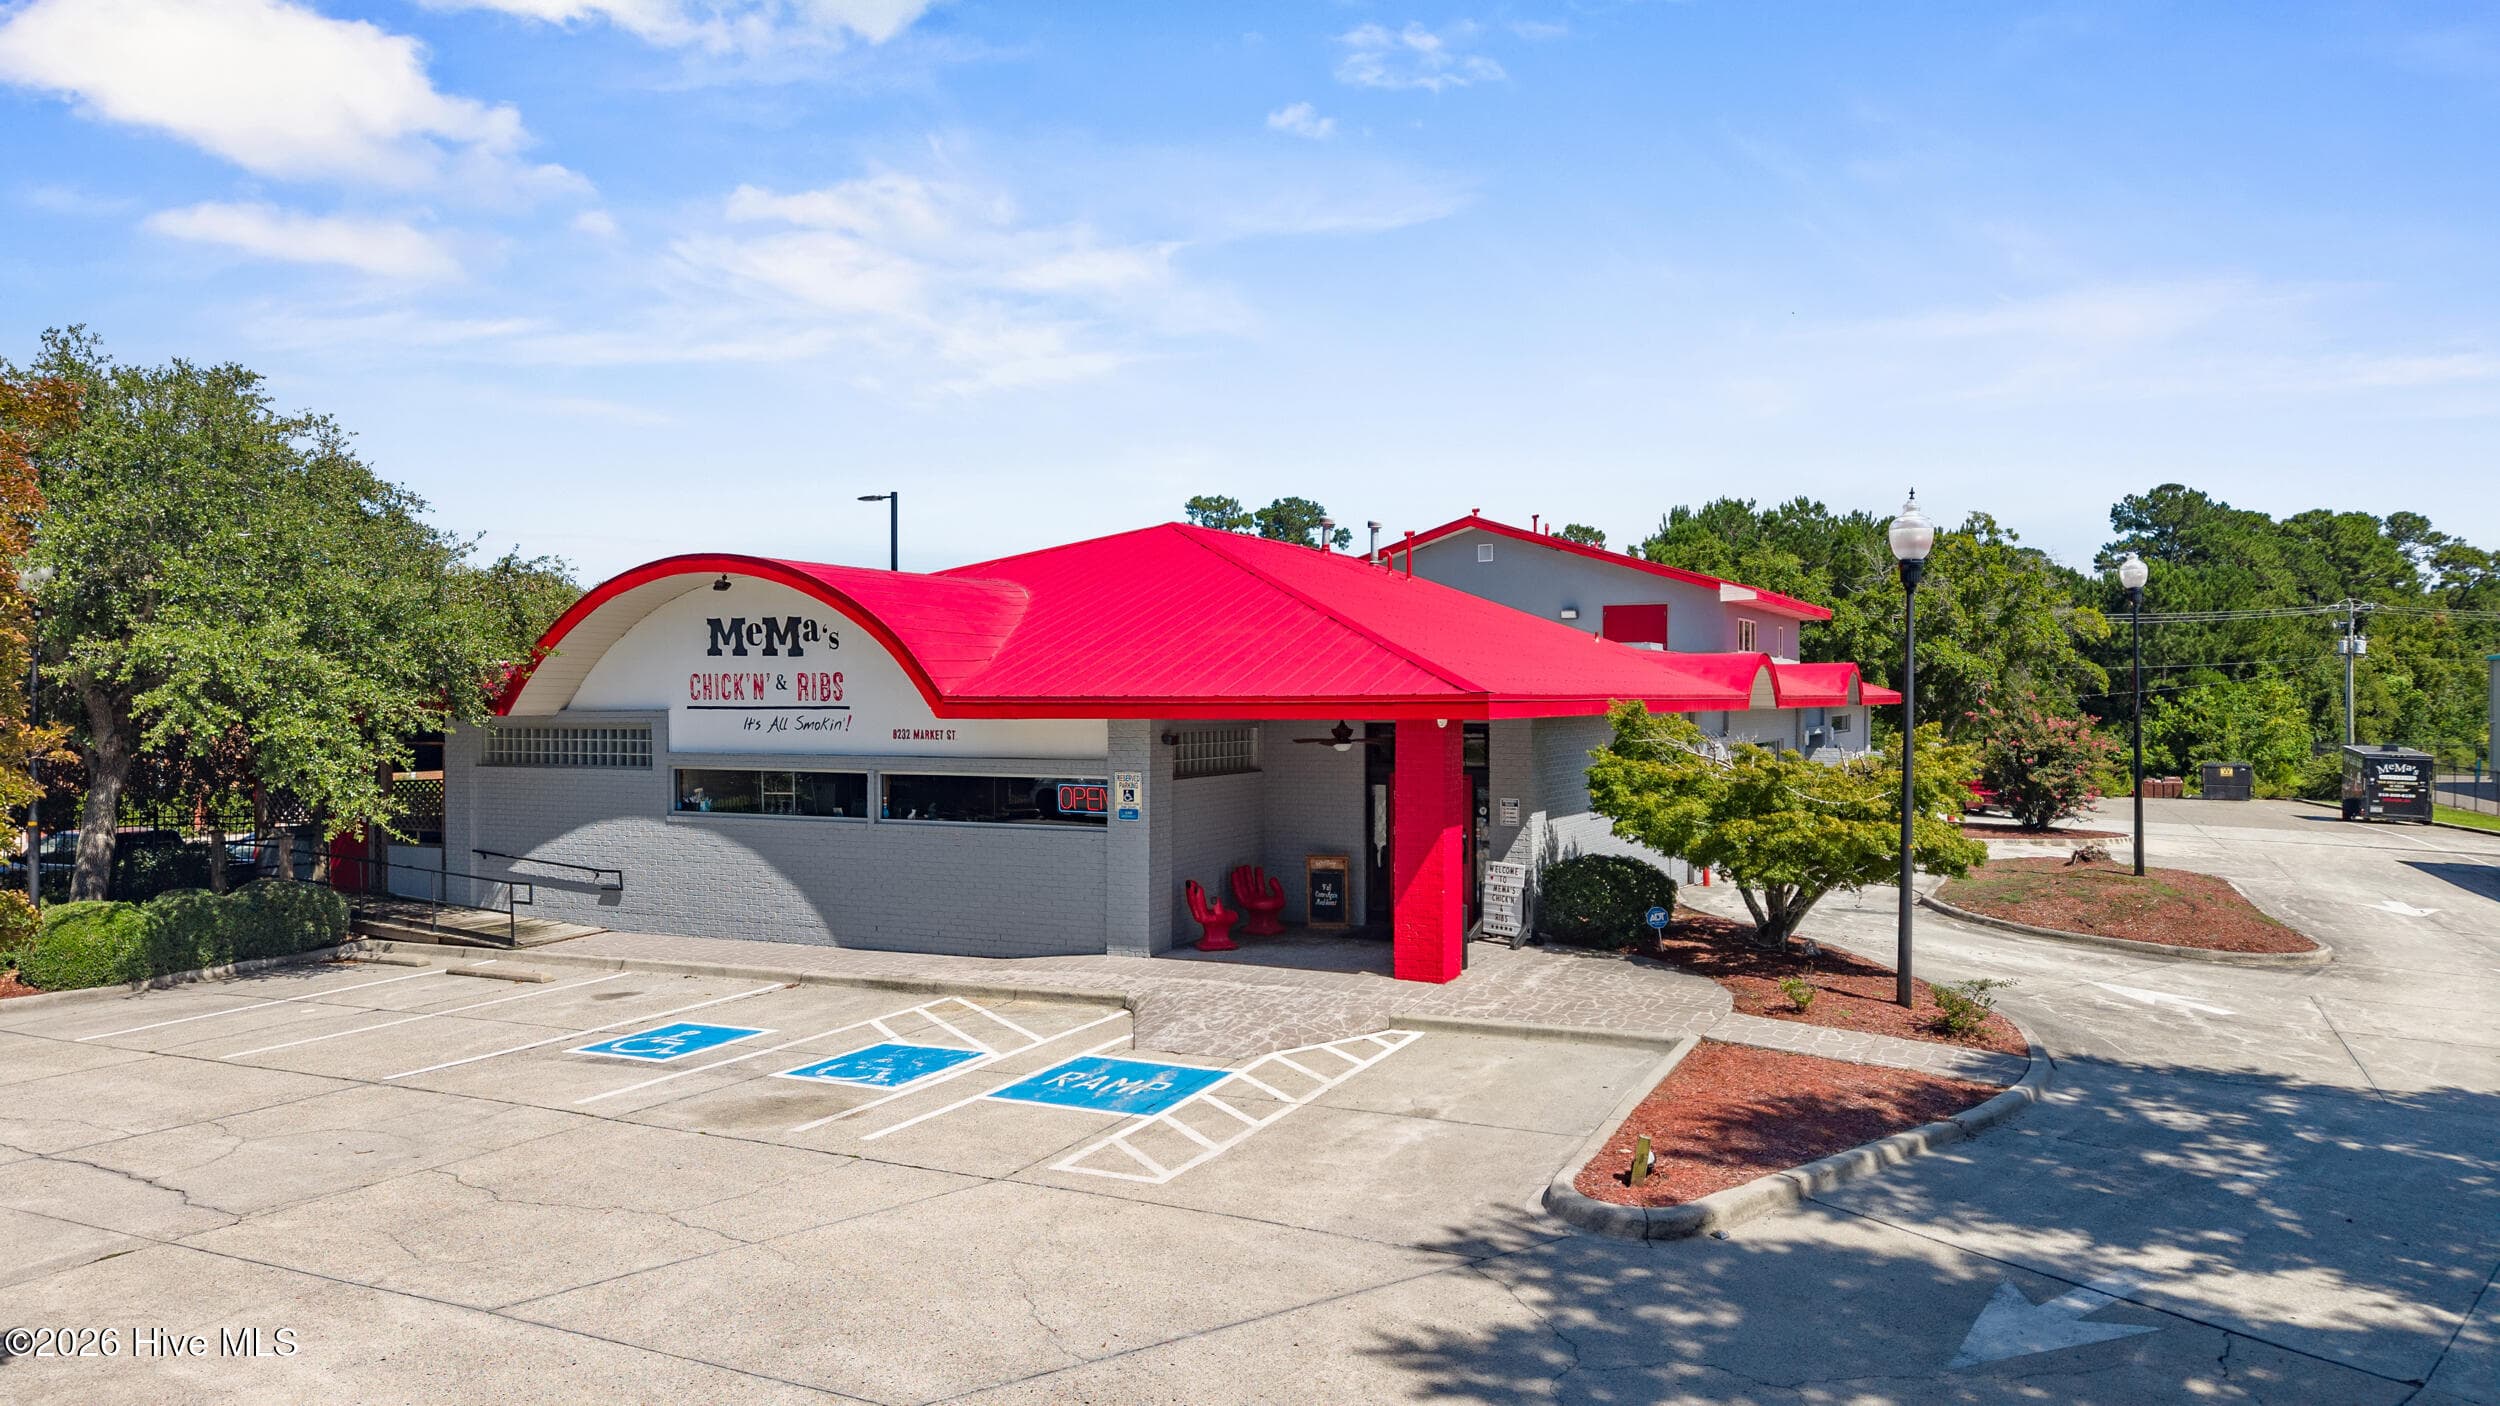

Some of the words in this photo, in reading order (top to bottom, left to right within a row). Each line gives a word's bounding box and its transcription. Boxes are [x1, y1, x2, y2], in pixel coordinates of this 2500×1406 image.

[706, 616, 840, 657] MeMa's
[775, 674, 788, 691] &
[797, 671, 844, 702] RIBS
[743, 716, 761, 731] It's
[767, 716, 788, 733] All
[892, 729, 911, 740] 8232
[913, 729, 944, 741] MARKET
[946, 729, 957, 741] ST
[1060, 786, 1108, 811] OPEN
[1489, 865, 1519, 876] WELCOME
[1499, 876, 1507, 884] TO
[1495, 913, 1508, 922] RIBS
[1650, 911, 1666, 921] ADT
[1041, 1071, 1174, 1100] RAMP
